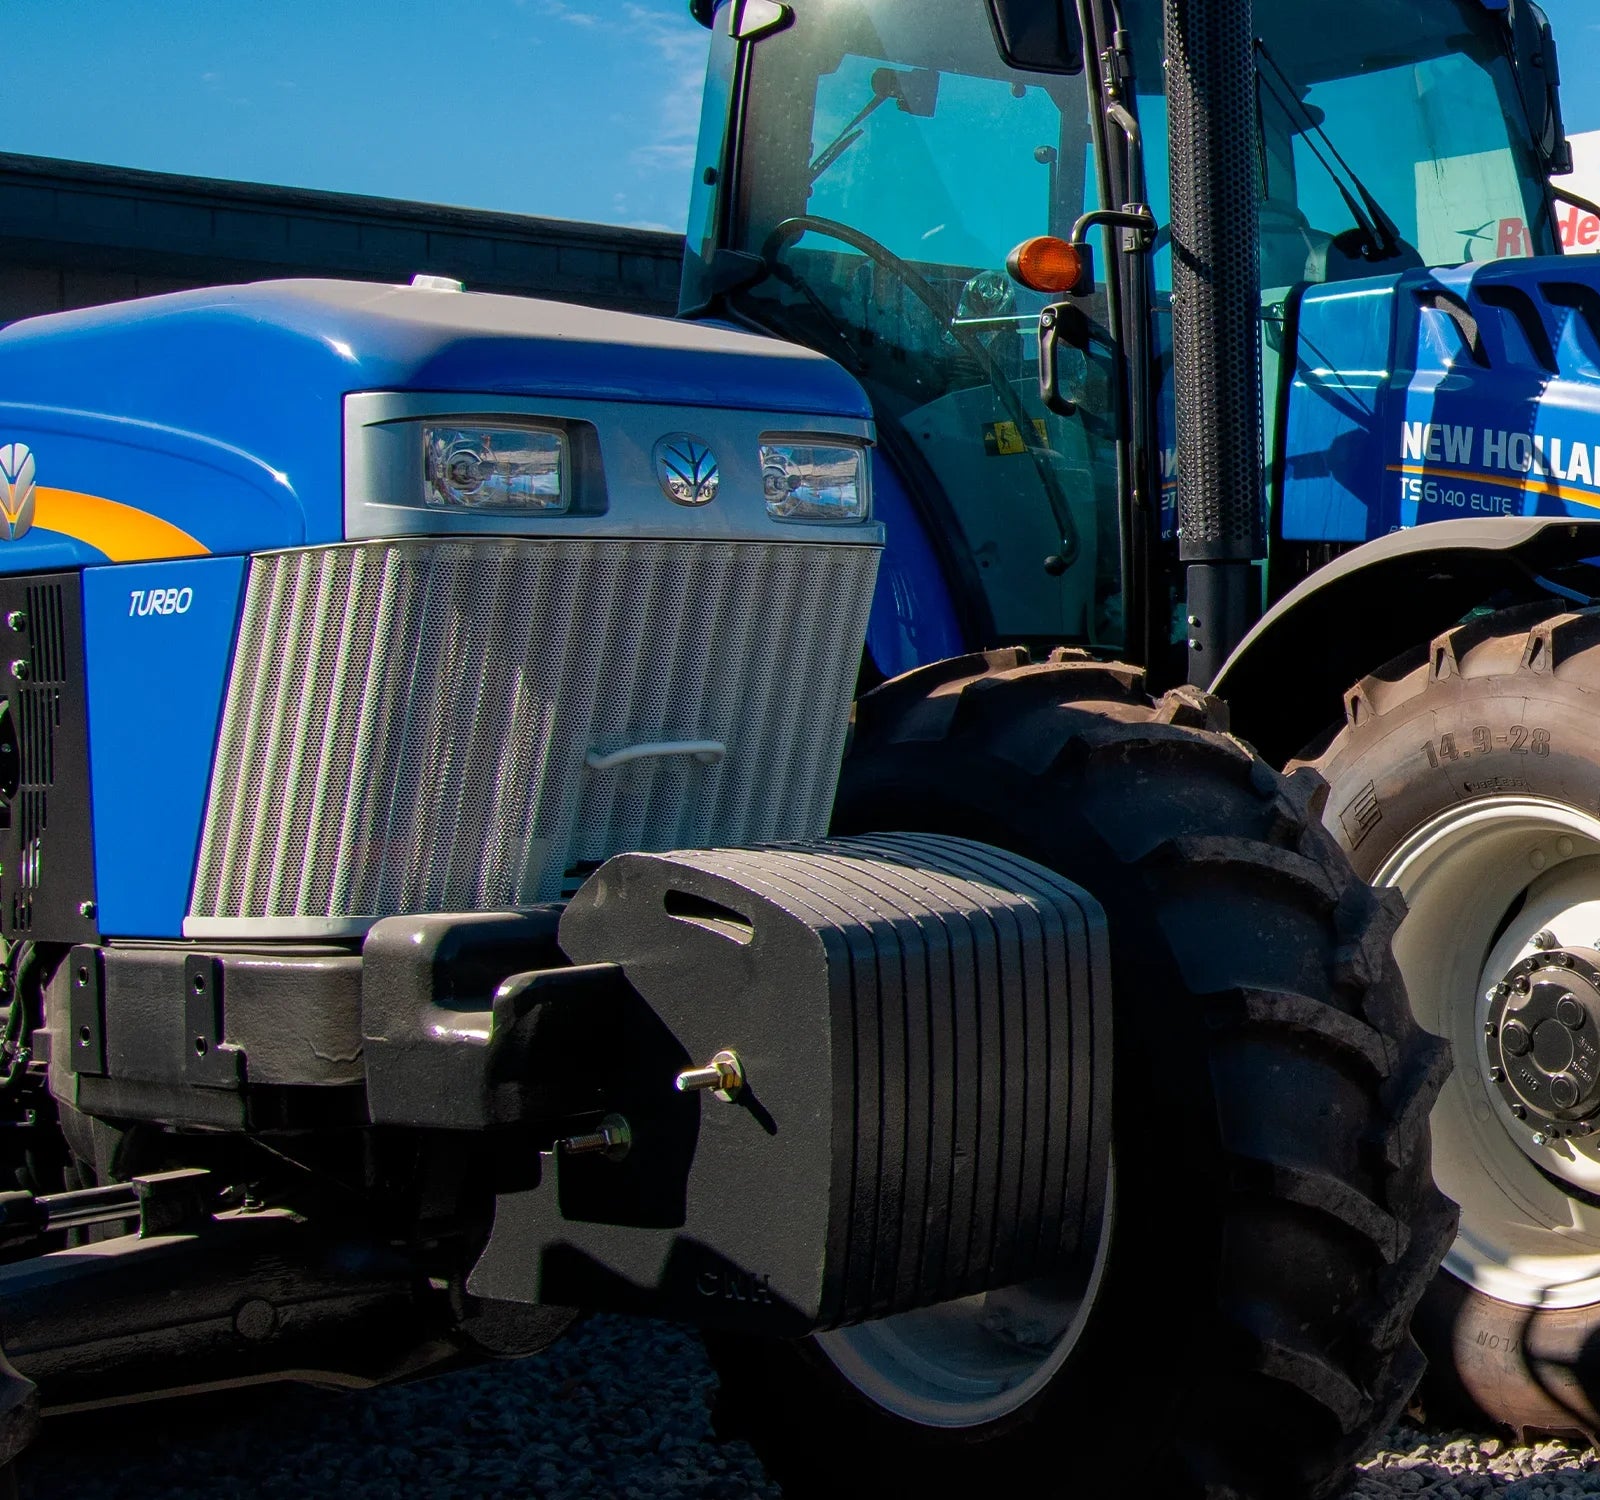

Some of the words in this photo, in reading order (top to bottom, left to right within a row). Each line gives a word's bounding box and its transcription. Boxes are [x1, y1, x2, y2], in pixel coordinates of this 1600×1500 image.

[1401, 421, 1474, 465] NEW
[1470, 493, 1513, 515] ELITE
[129, 587, 193, 617] TURBO
[1420, 724, 1552, 769] 14.9-28
